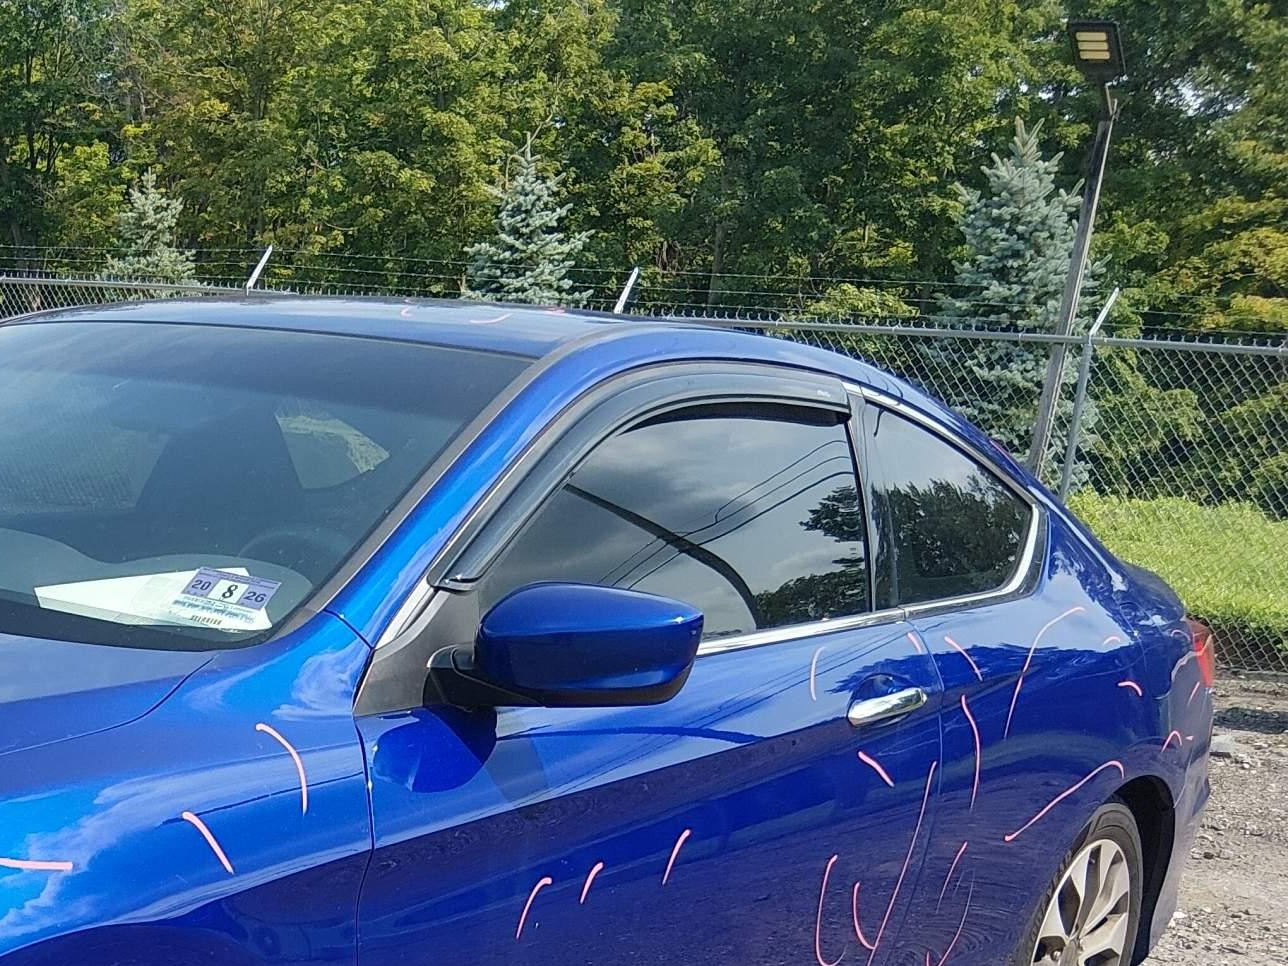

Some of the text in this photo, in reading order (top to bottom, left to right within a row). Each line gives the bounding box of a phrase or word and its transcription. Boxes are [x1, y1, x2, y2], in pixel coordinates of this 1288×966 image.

[191, 579, 212, 592] 20
[221, 584, 239, 599] 8
[243, 591, 267, 603] 26
